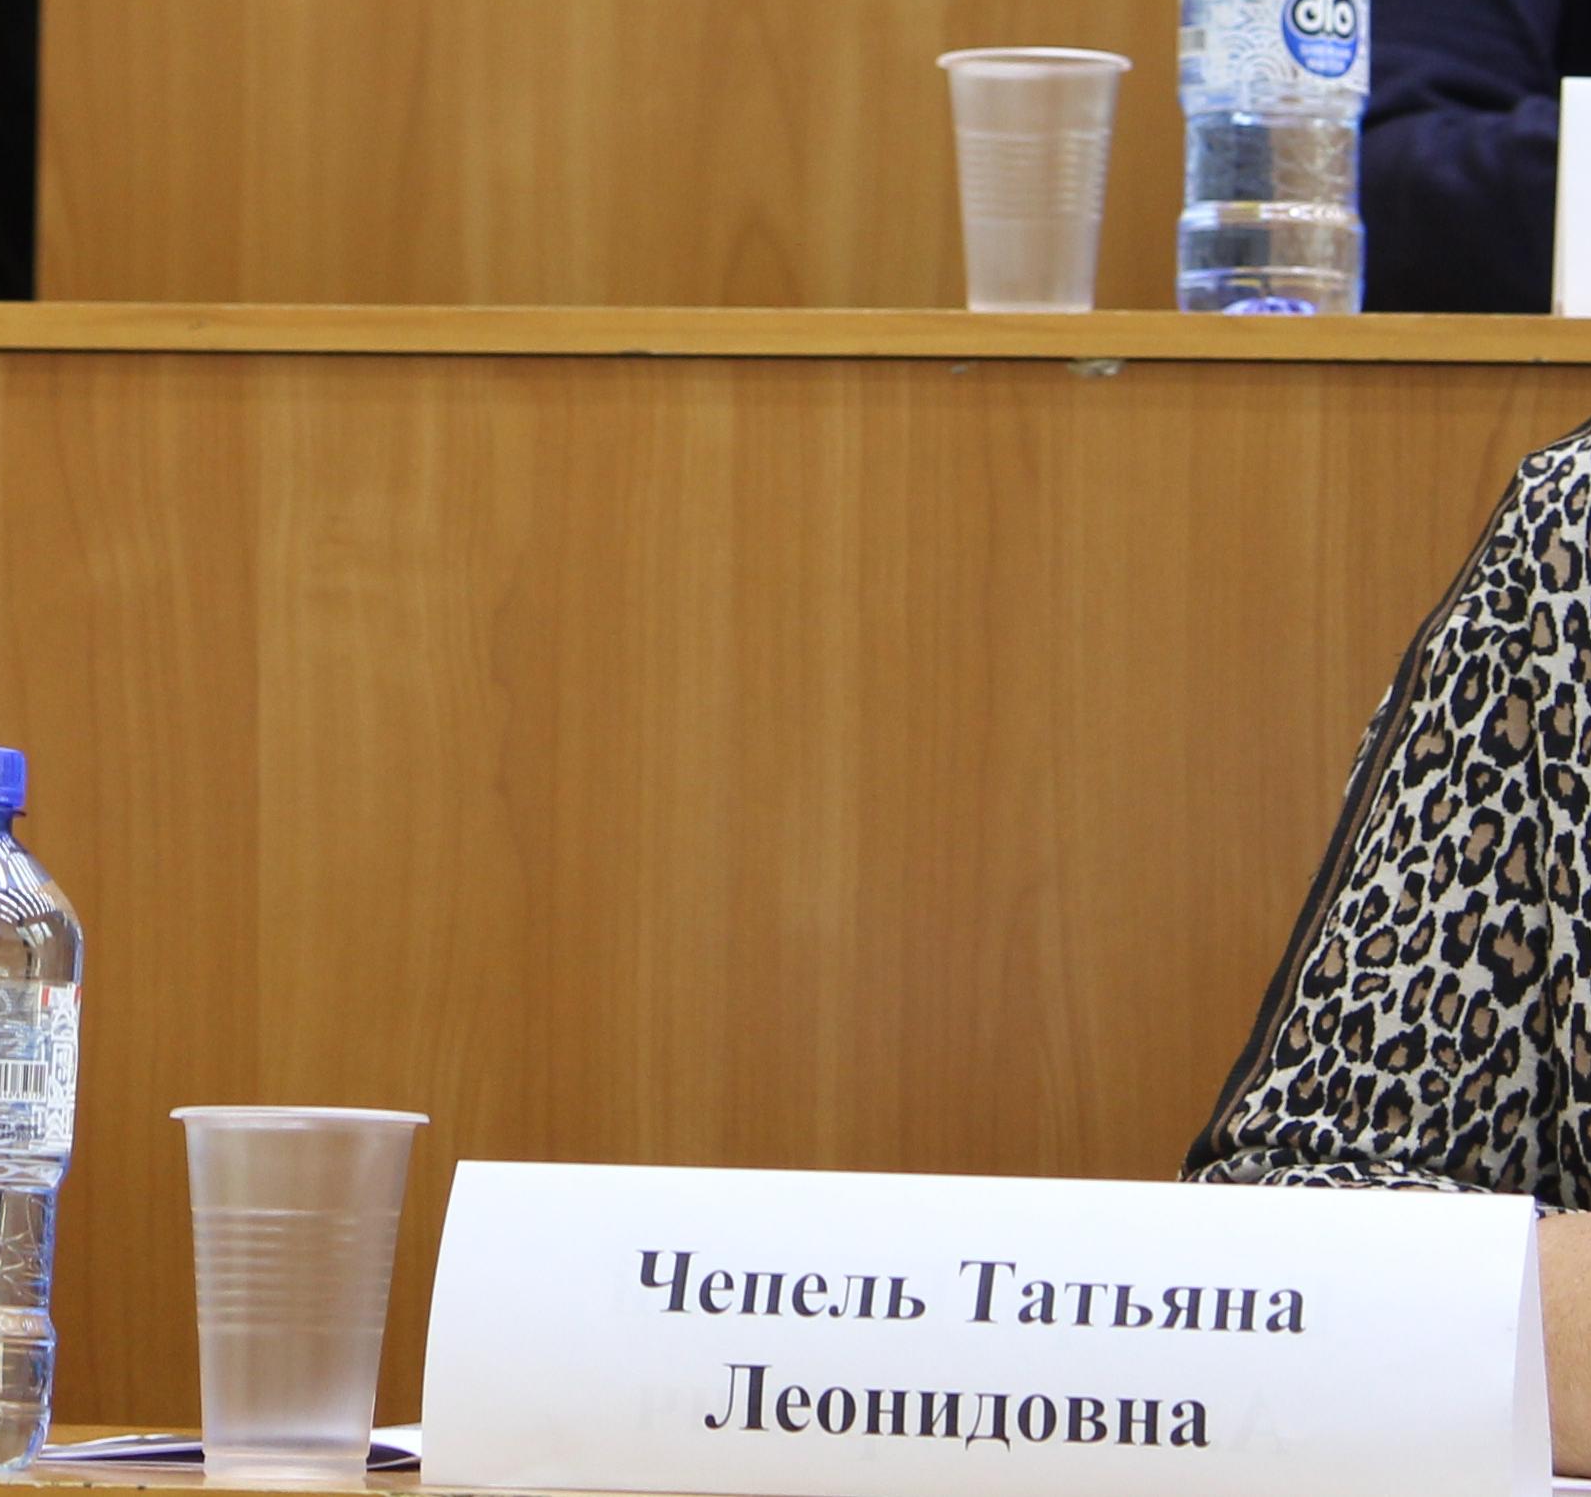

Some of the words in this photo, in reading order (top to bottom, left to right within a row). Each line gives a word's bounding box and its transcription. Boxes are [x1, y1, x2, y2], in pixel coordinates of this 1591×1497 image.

[638, 1249, 928, 1320] Чепель
[959, 1259, 1306, 1334] Татьяна
[703, 1362, 1210, 1451] Леонидовна
